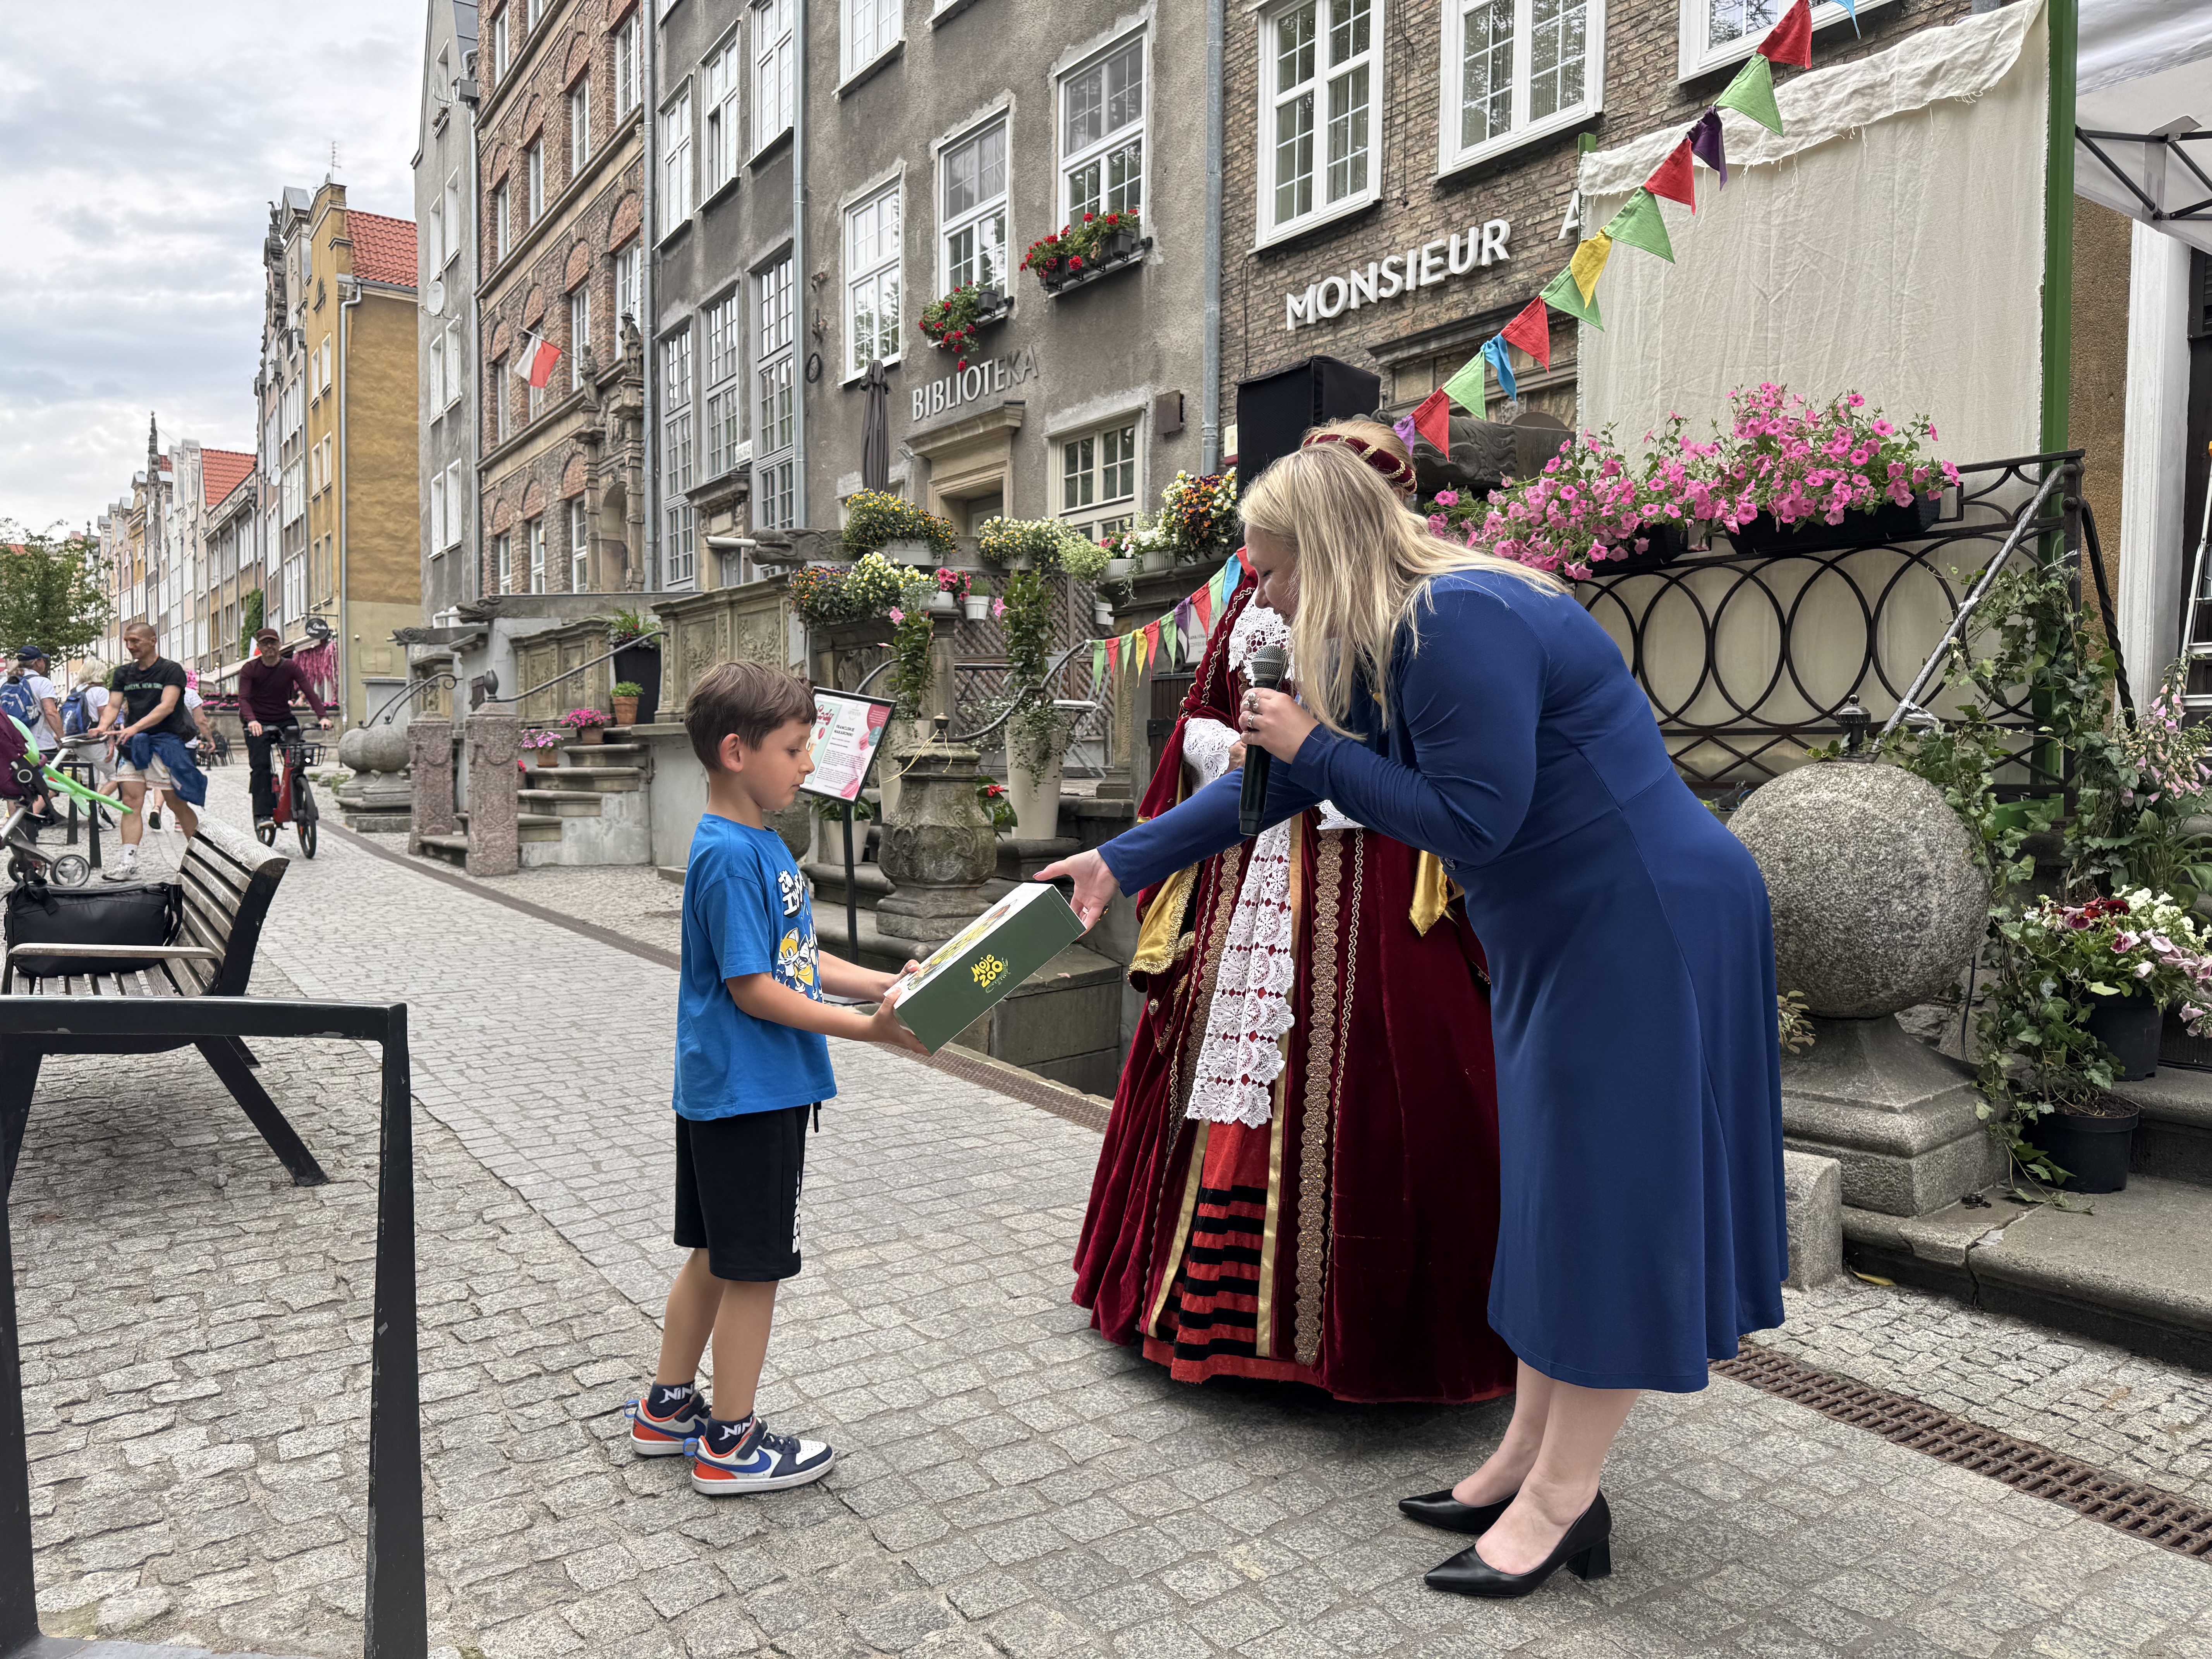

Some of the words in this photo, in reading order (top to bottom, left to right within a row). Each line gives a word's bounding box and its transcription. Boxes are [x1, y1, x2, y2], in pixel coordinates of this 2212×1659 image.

[1286, 219, 1510, 330] MONSIEUR
[913, 345, 1039, 421] BIBLIOTEKA
[971, 954, 994, 982] Moje
